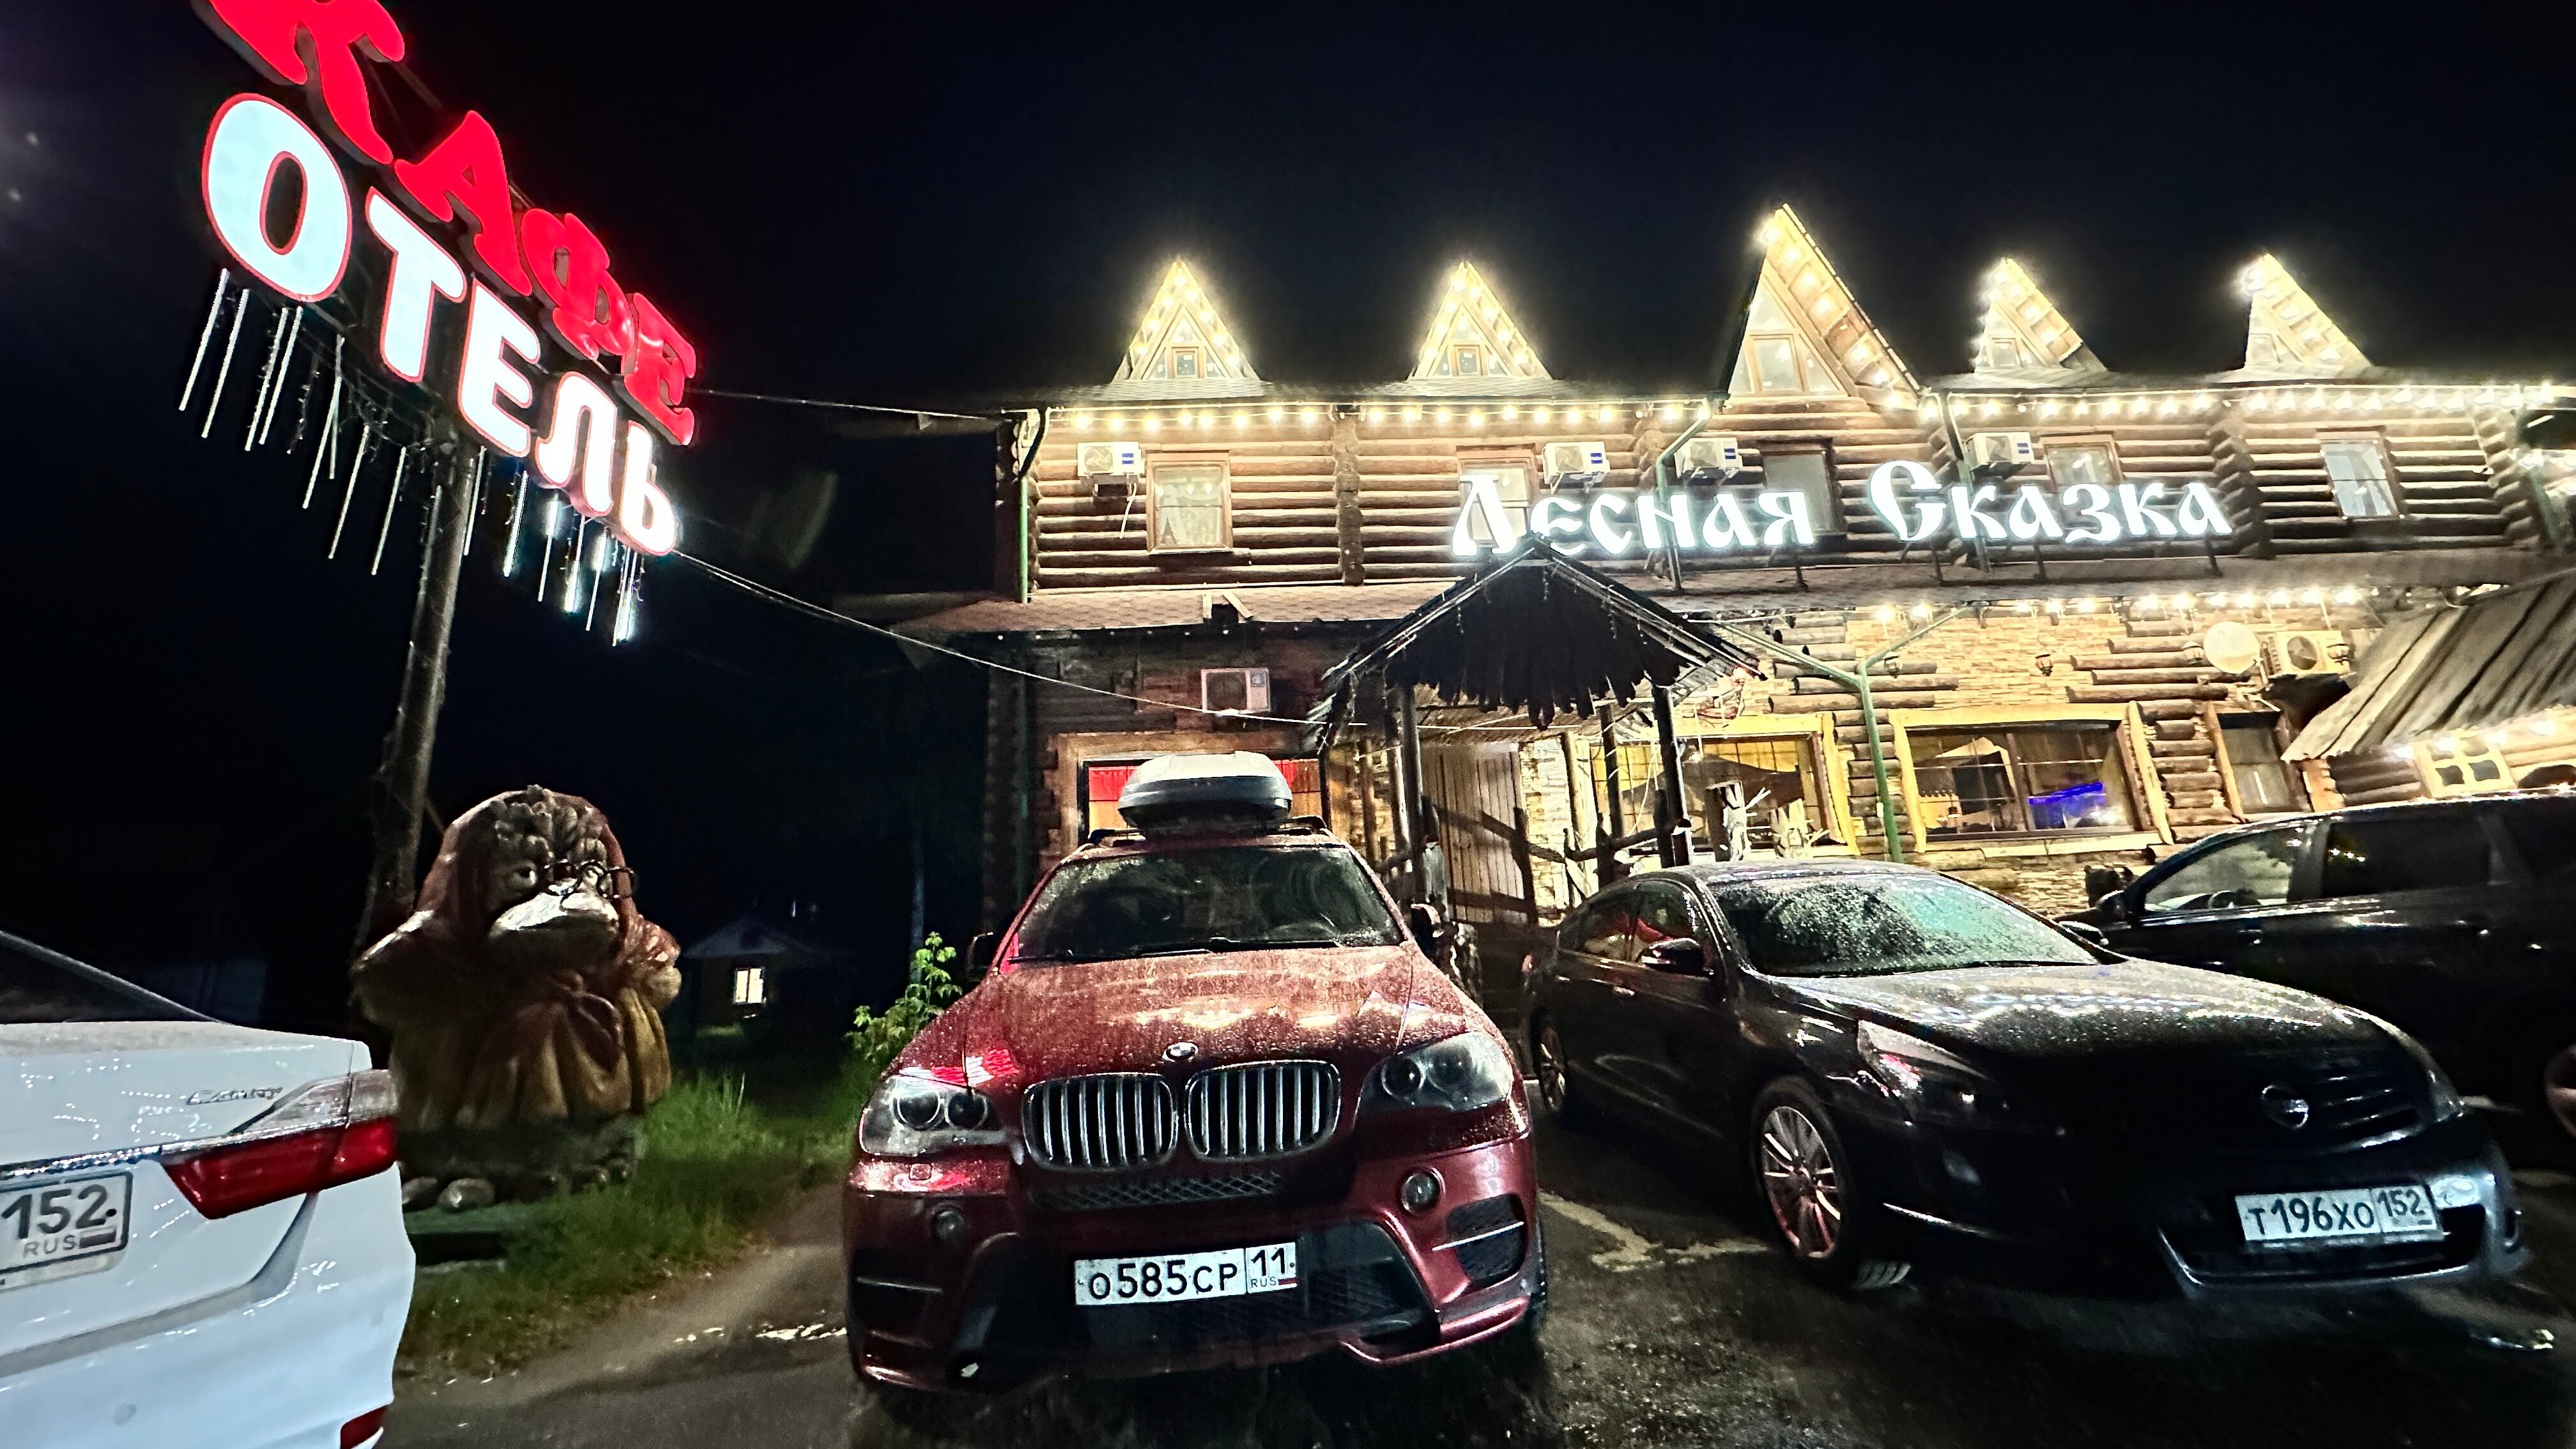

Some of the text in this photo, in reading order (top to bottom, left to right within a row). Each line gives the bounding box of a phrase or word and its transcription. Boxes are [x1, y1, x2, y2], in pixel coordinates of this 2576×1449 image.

[201, 0, 696, 446] КАФЕ
[201, 93, 675, 555] ОТЕЛЬ
[1452, 460, 2232, 556] Лесная Сказка
[2, 1184, 107, 1239] 152
[23, 1235, 76, 1257] RUS
[1251, 1276, 1276, 1288] RUS
